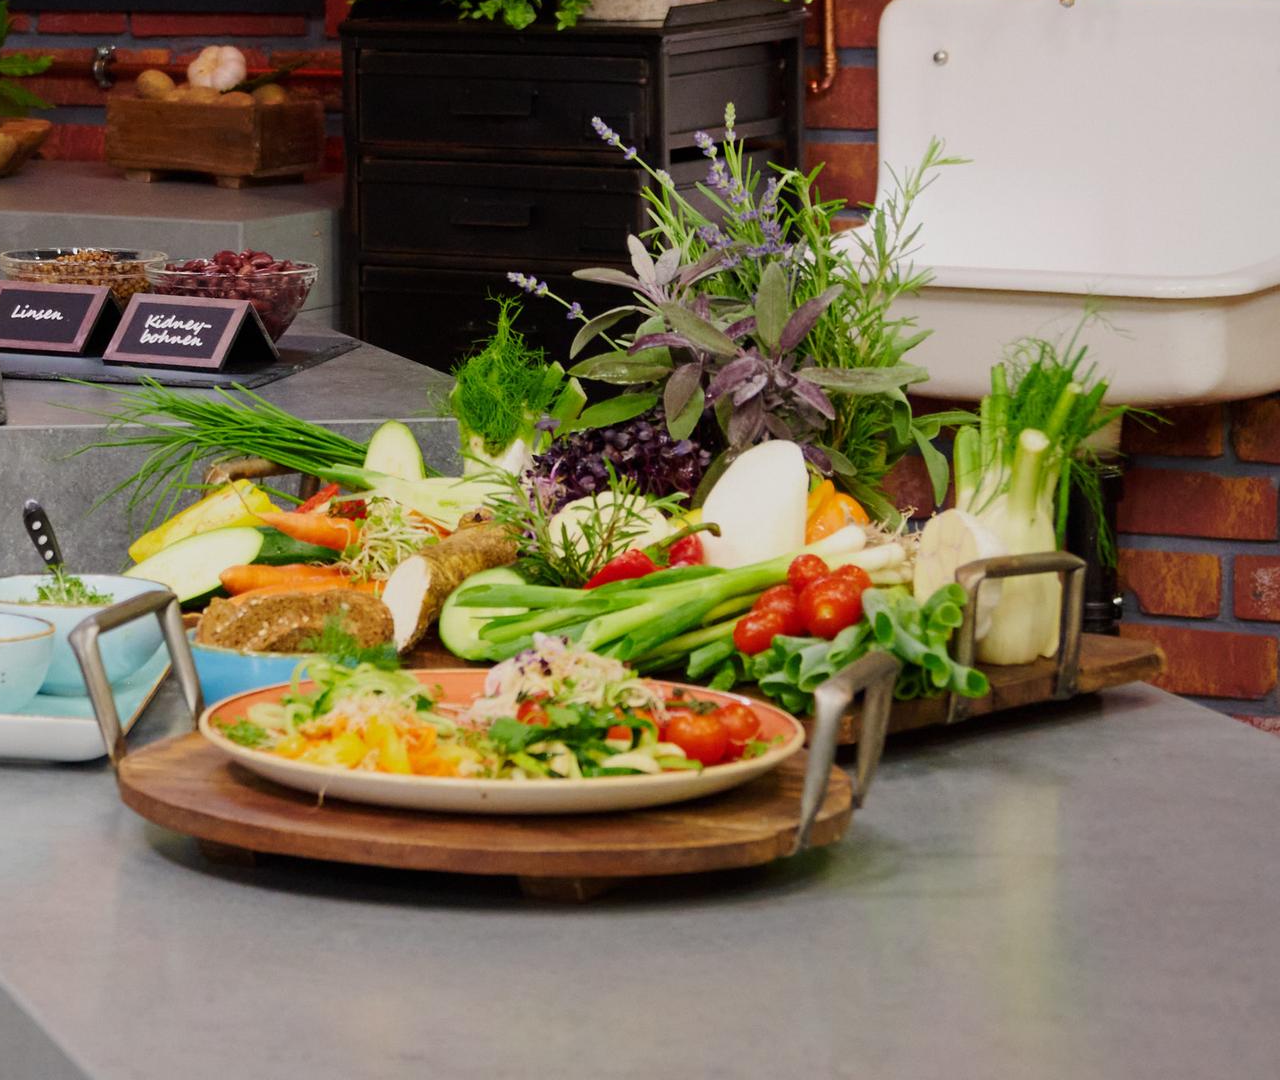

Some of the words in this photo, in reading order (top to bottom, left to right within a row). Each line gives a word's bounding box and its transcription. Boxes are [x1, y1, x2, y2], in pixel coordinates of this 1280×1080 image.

[11, 304, 63, 320] Linsen
[144, 314, 212, 335] Kidney-
[139, 328, 203, 346] bohnen
